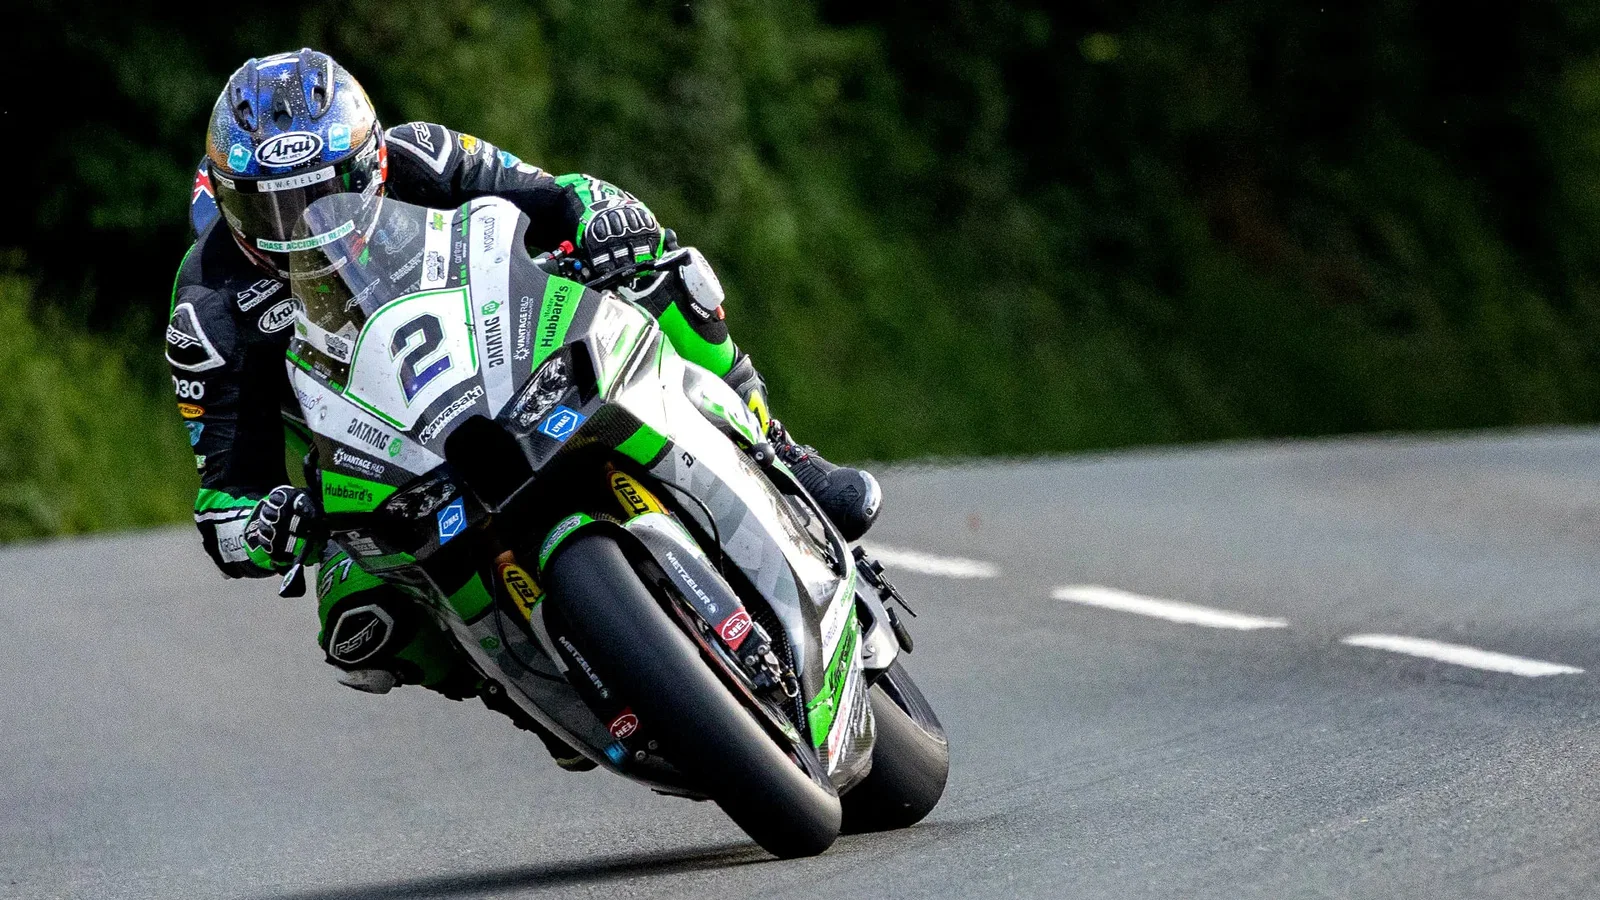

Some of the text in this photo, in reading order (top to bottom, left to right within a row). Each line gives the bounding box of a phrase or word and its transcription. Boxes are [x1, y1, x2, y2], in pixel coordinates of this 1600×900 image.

[262, 135, 312, 161] Arai
[258, 173, 322, 189] NEWFIELD
[259, 222, 353, 250] CHASE ACCIDENT REPAIR
[483, 216, 495, 252] MORELLO
[518, 312, 528, 349] VANTAGE
[541, 285, 569, 348] Hubbard's
[390, 313, 452, 404] 2
[484, 316, 504, 369] DATATAG
[420, 386, 484, 444] Kawasaki
[347, 418, 390, 451] DATATAG
[343, 451, 371, 470] VANTAGE
[325, 483, 373, 501] Hubbard's
[665, 551, 711, 605] METZELER
[335, 618, 379, 656] RST
[727, 618, 749, 637] HEL
[558, 636, 603, 689] METZELER
[615, 720, 634, 738] HEL
